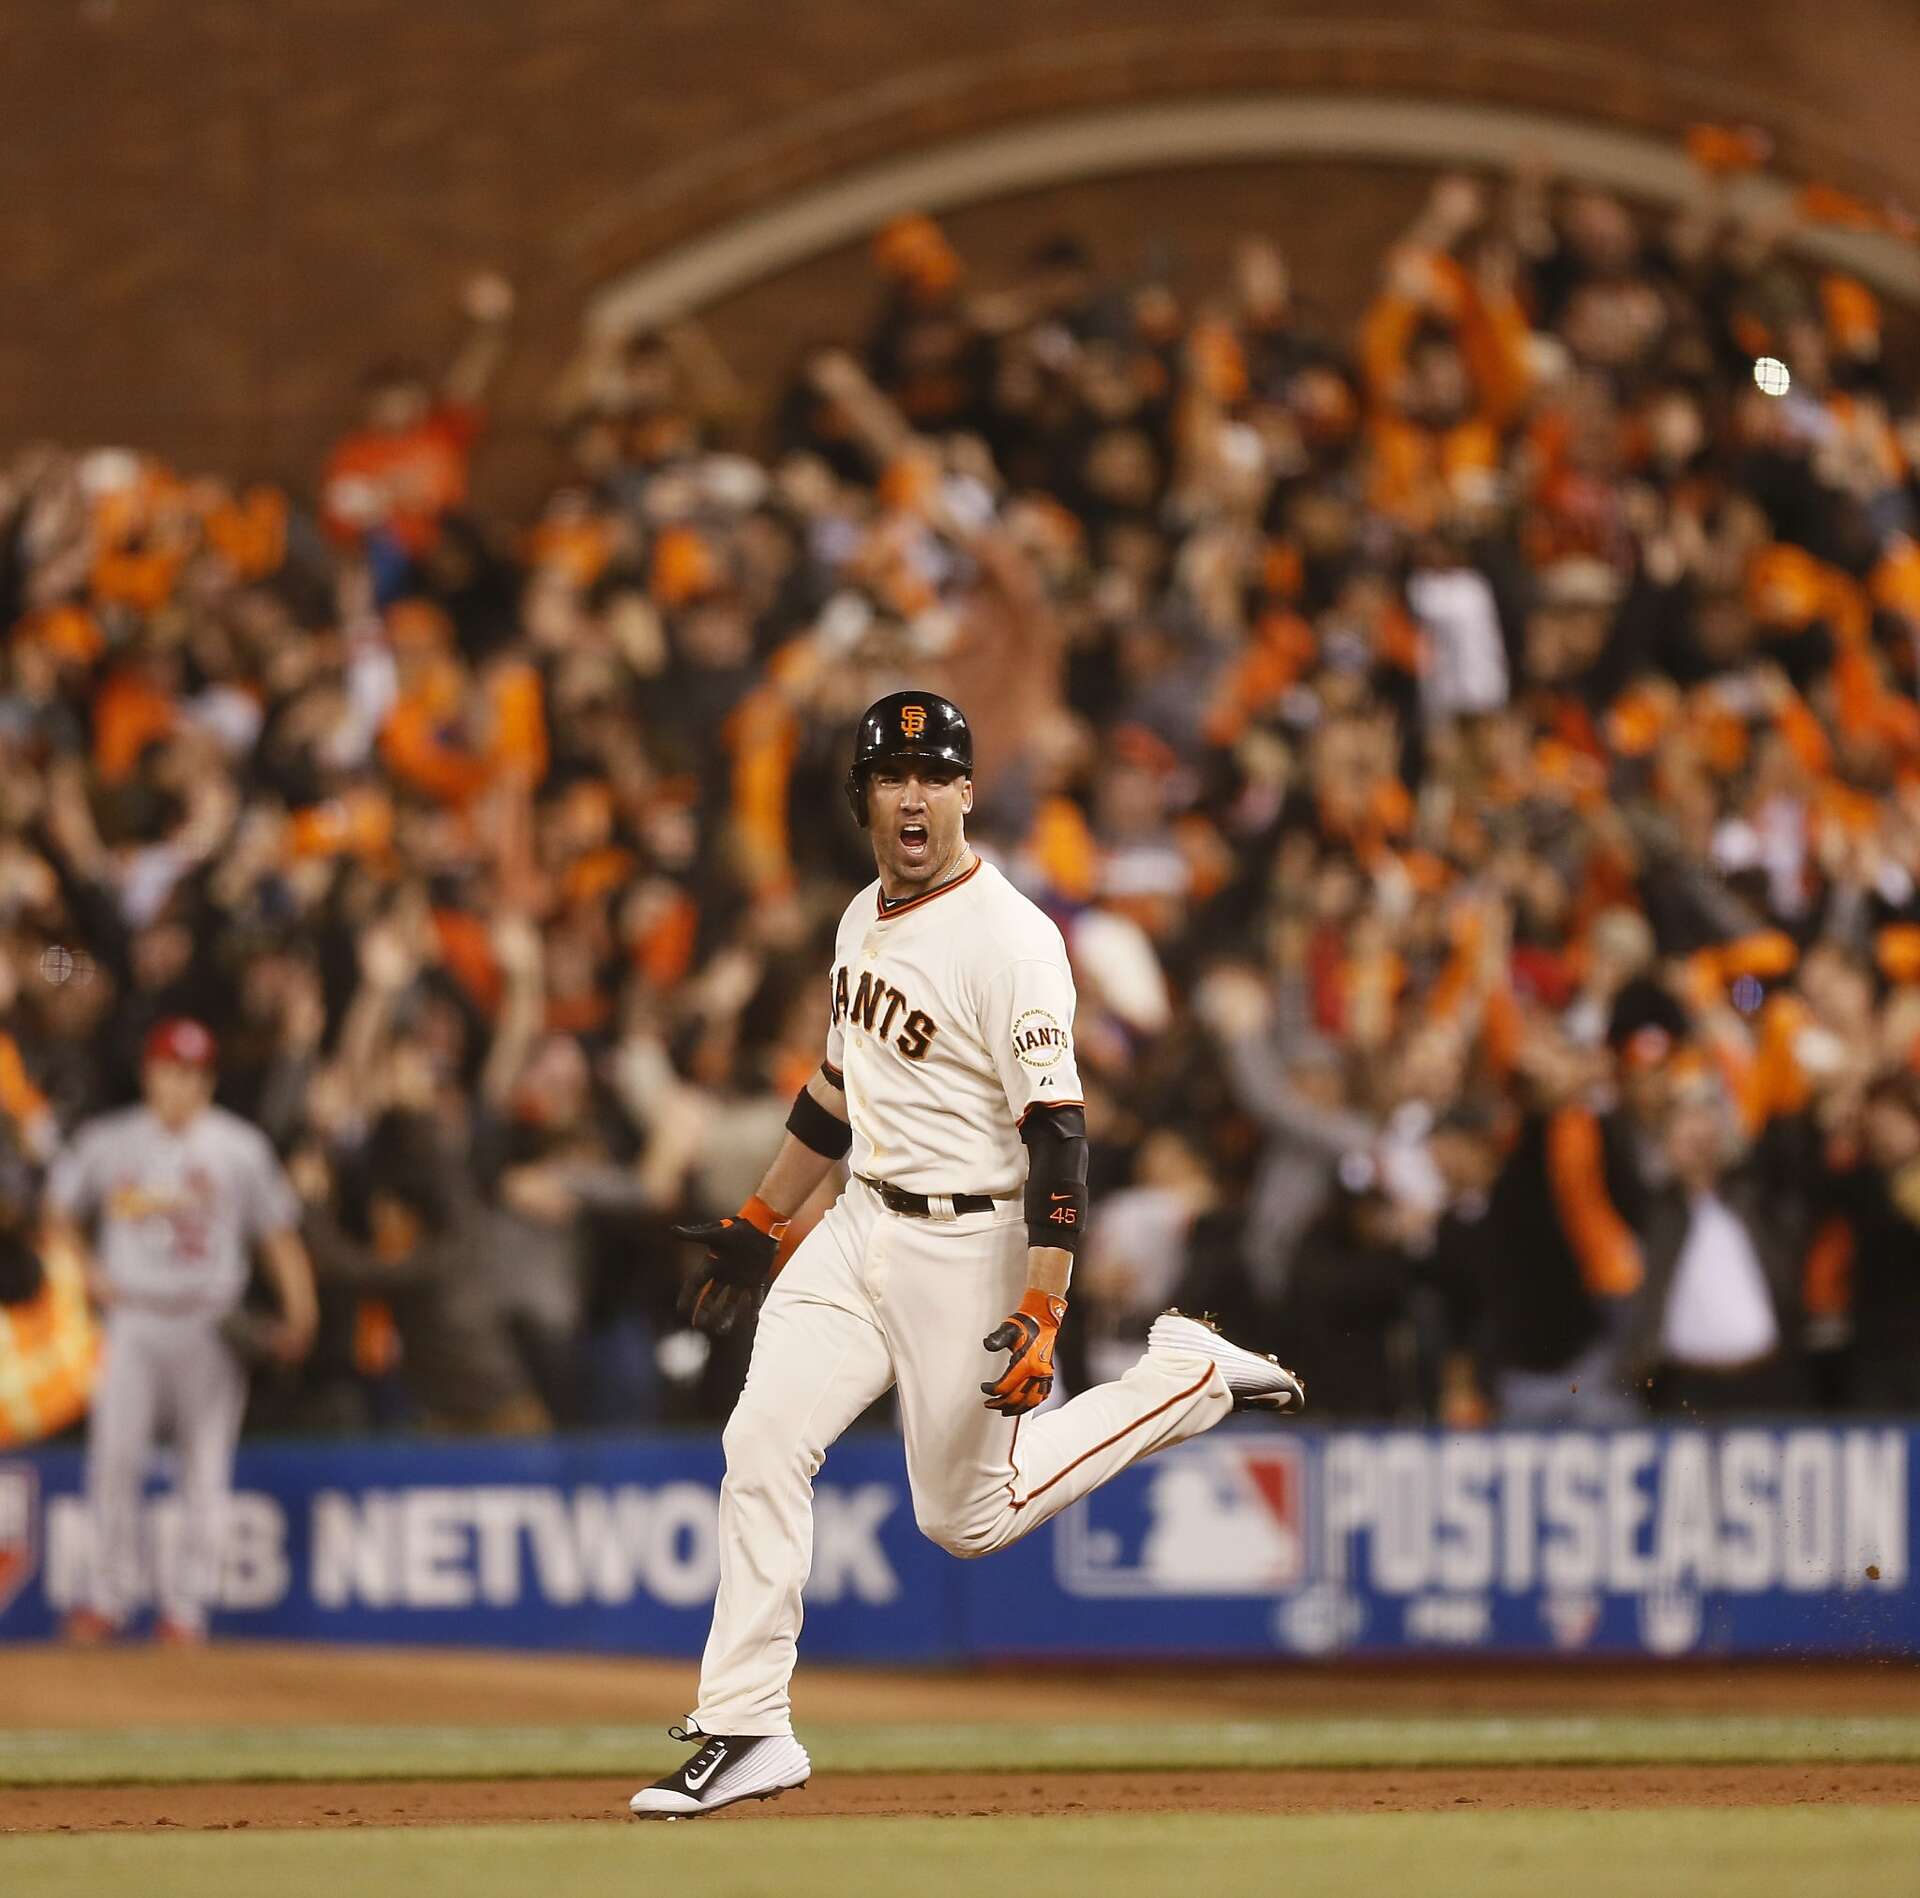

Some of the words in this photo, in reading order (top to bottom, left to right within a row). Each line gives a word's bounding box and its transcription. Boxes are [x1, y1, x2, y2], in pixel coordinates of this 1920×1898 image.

[901, 705, 927, 737] SF
[1049, 1207, 1077, 1224] 45
[311, 1485, 900, 1608] NETWOK
[1324, 1430, 1907, 1594] POSTSEASON
